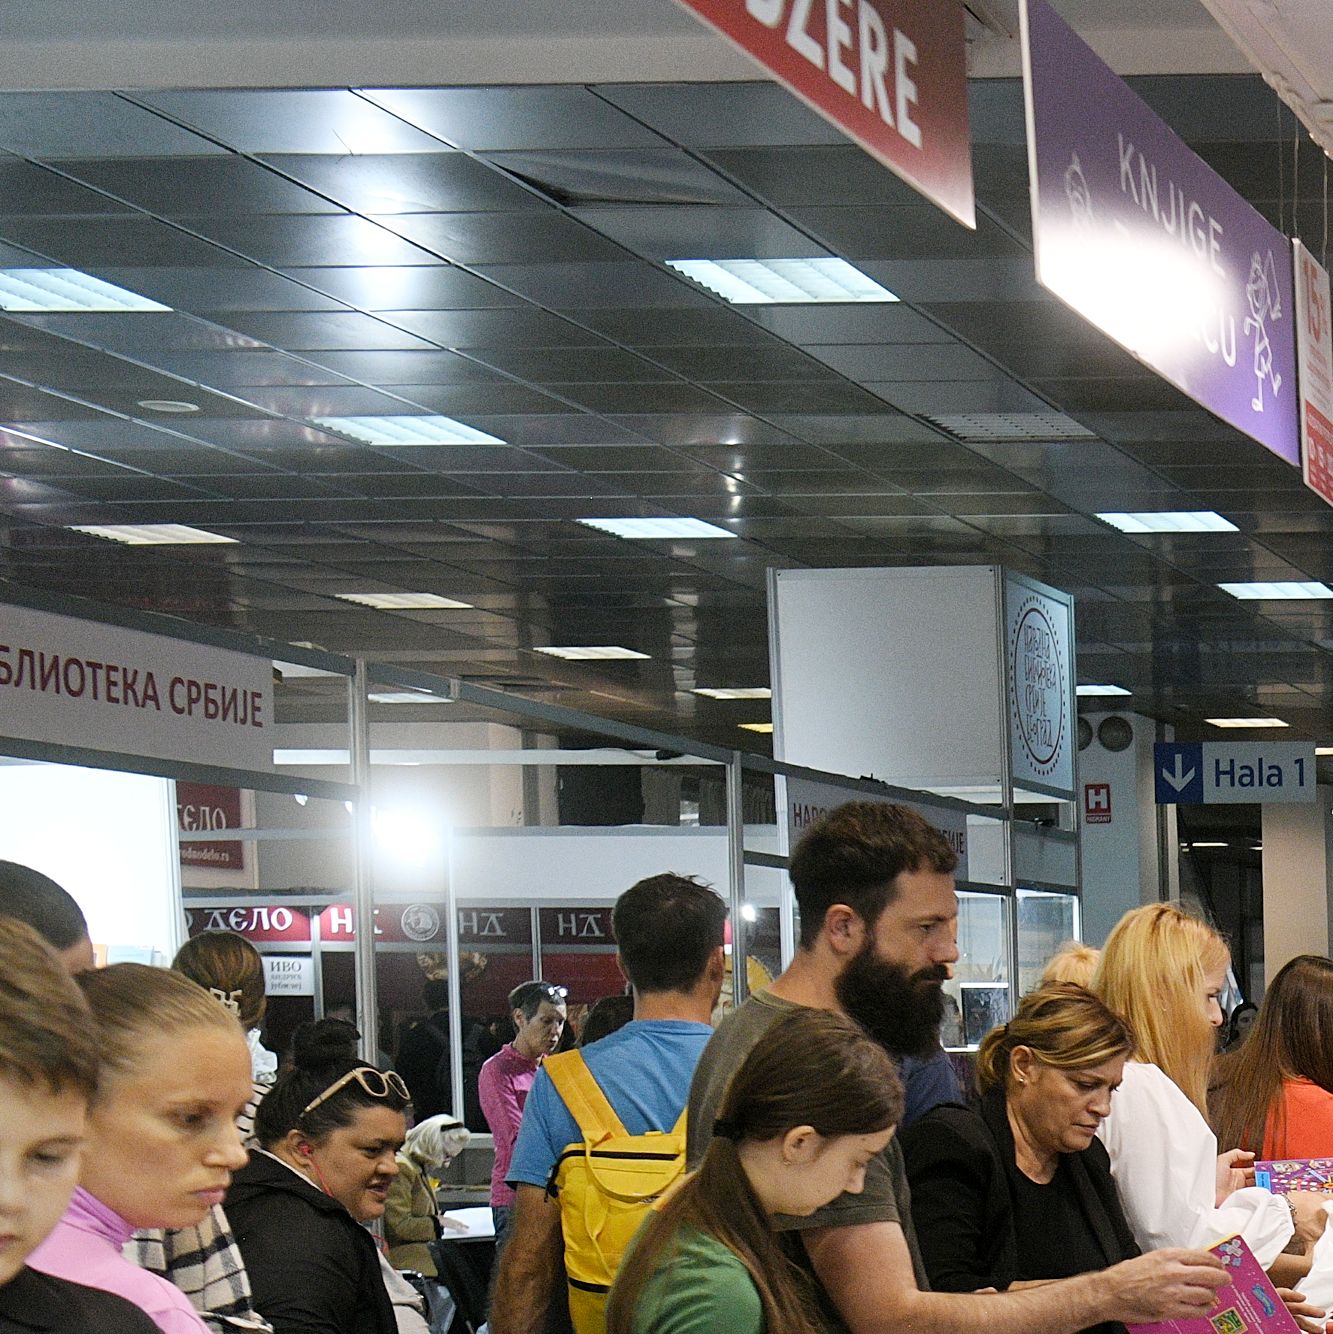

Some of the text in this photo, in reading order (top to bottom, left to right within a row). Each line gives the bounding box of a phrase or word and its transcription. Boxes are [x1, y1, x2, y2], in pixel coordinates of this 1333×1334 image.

[1118, 132, 1226, 279] KNJIGE
[168, 676, 264, 728] СРБИЈЕ
[1214, 757, 1305, 788] Hala 1
[203, 907, 293, 931] ДЕЛО
[270, 960, 301, 972] ИВО
